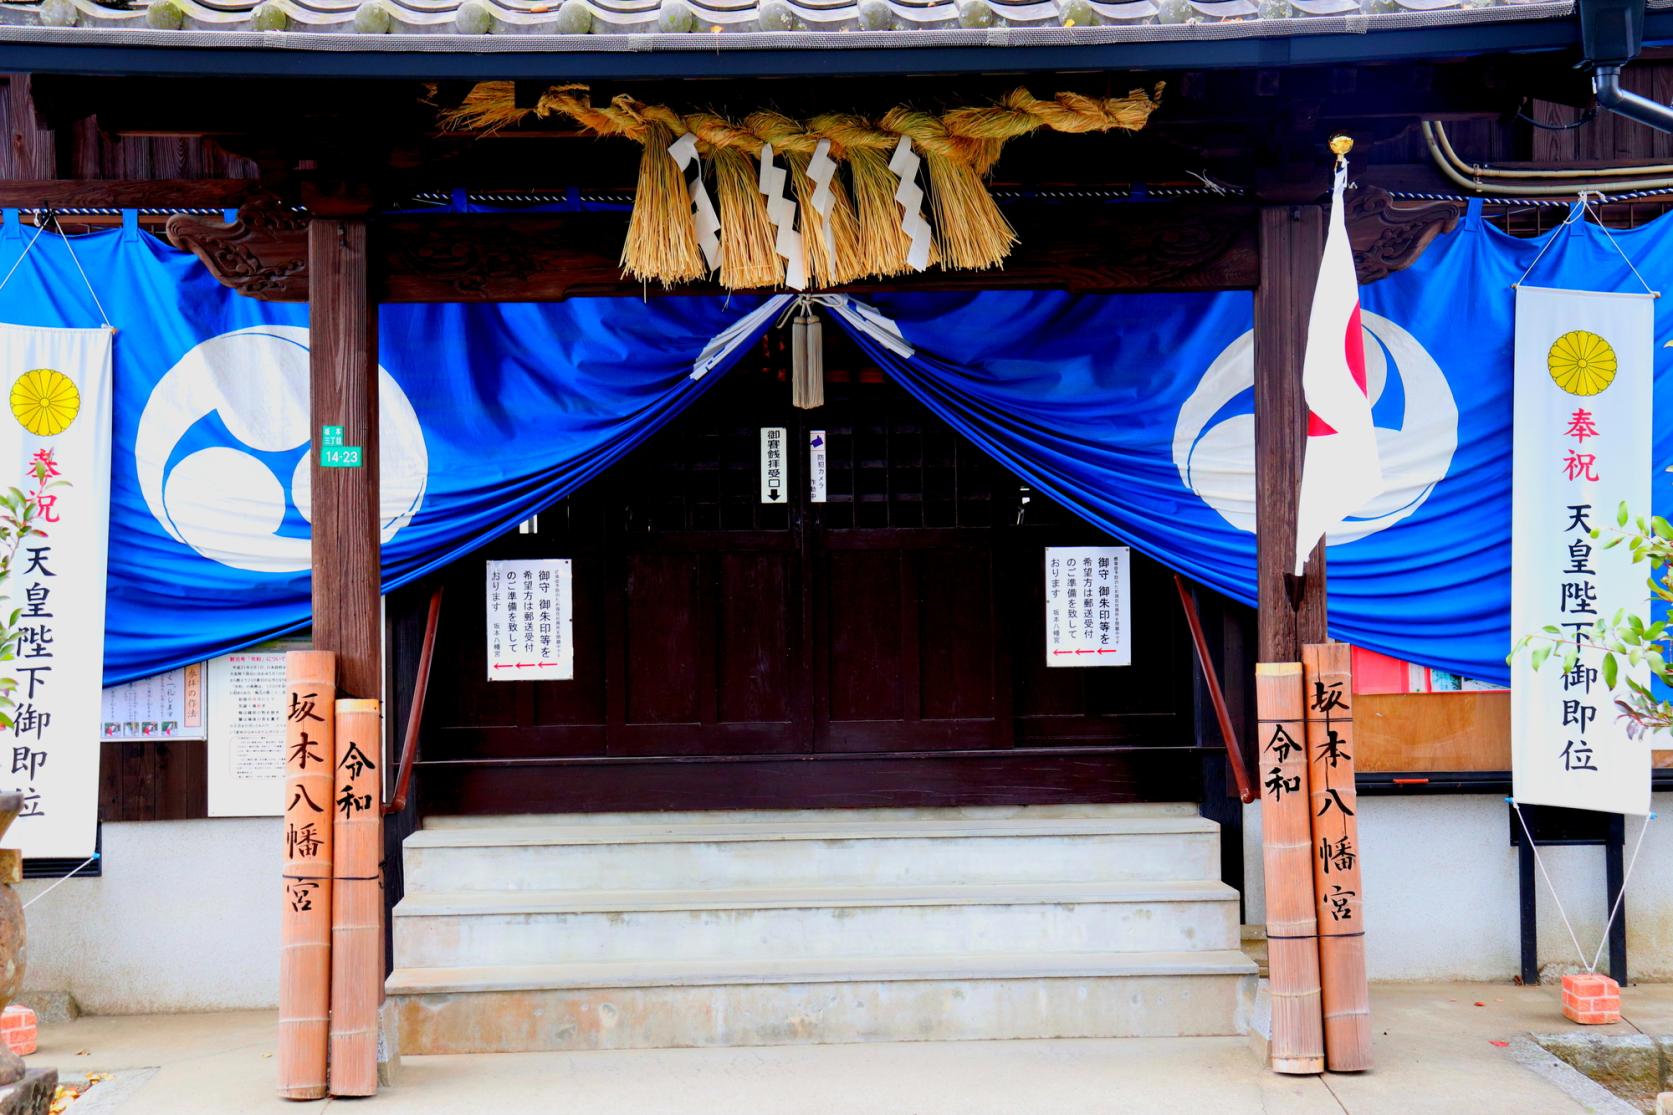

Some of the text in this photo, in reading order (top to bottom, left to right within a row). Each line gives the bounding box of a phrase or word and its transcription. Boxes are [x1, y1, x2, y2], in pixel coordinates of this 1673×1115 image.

[326, 450, 358, 463] 14-23
[491, 571, 501, 612] おります
[506, 571, 518, 654] のご準備を致して
[523, 570, 535, 653] 希望方は郵送受付
[538, 570, 552, 659] 御守 御朱印等を
[1050, 558, 1060, 599] おります
[1066, 558, 1077, 640] のご準備を致して
[1083, 557, 1094, 639] 希望方は郵送受付
[1098, 557, 1111, 645] 御守 御朱印等を
[1560, 407, 1600, 772] 奉祝 天皇陛下御即位
[10, 546, 57, 818] 天皇陛下御即位
[286, 692, 326, 913] 坂本八幡宮
[336, 741, 376, 820] 令和
[1263, 723, 1303, 803] 令和
[1310, 681, 1357, 922] 坂本八幡宮
